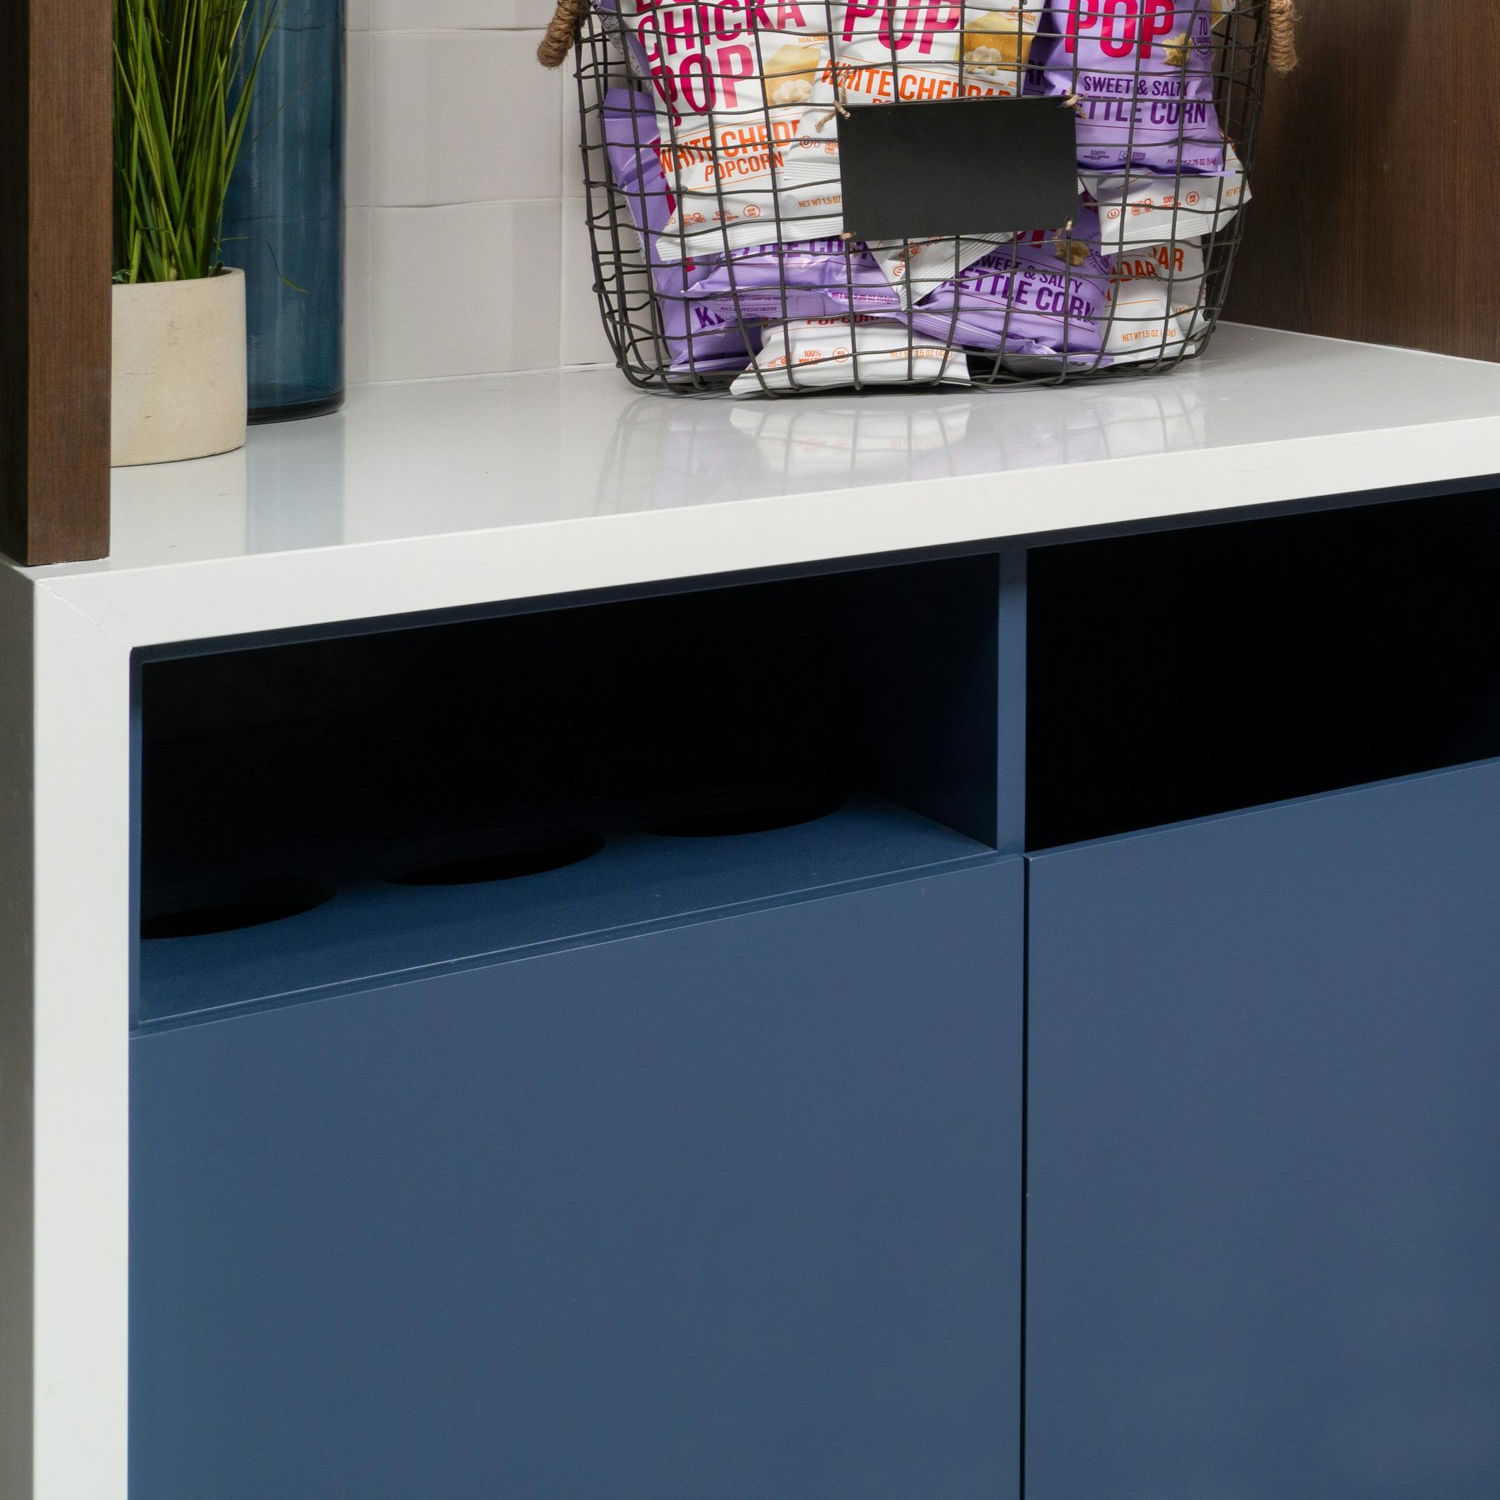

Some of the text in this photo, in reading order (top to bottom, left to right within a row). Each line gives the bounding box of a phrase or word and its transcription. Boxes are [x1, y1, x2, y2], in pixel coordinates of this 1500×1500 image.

[649, 44, 755, 128] POP
[1084, 76, 1190, 97] SWEET SALTY
[1151, 99, 1206, 125] CORN
[704, 151, 785, 183] POPCORN
